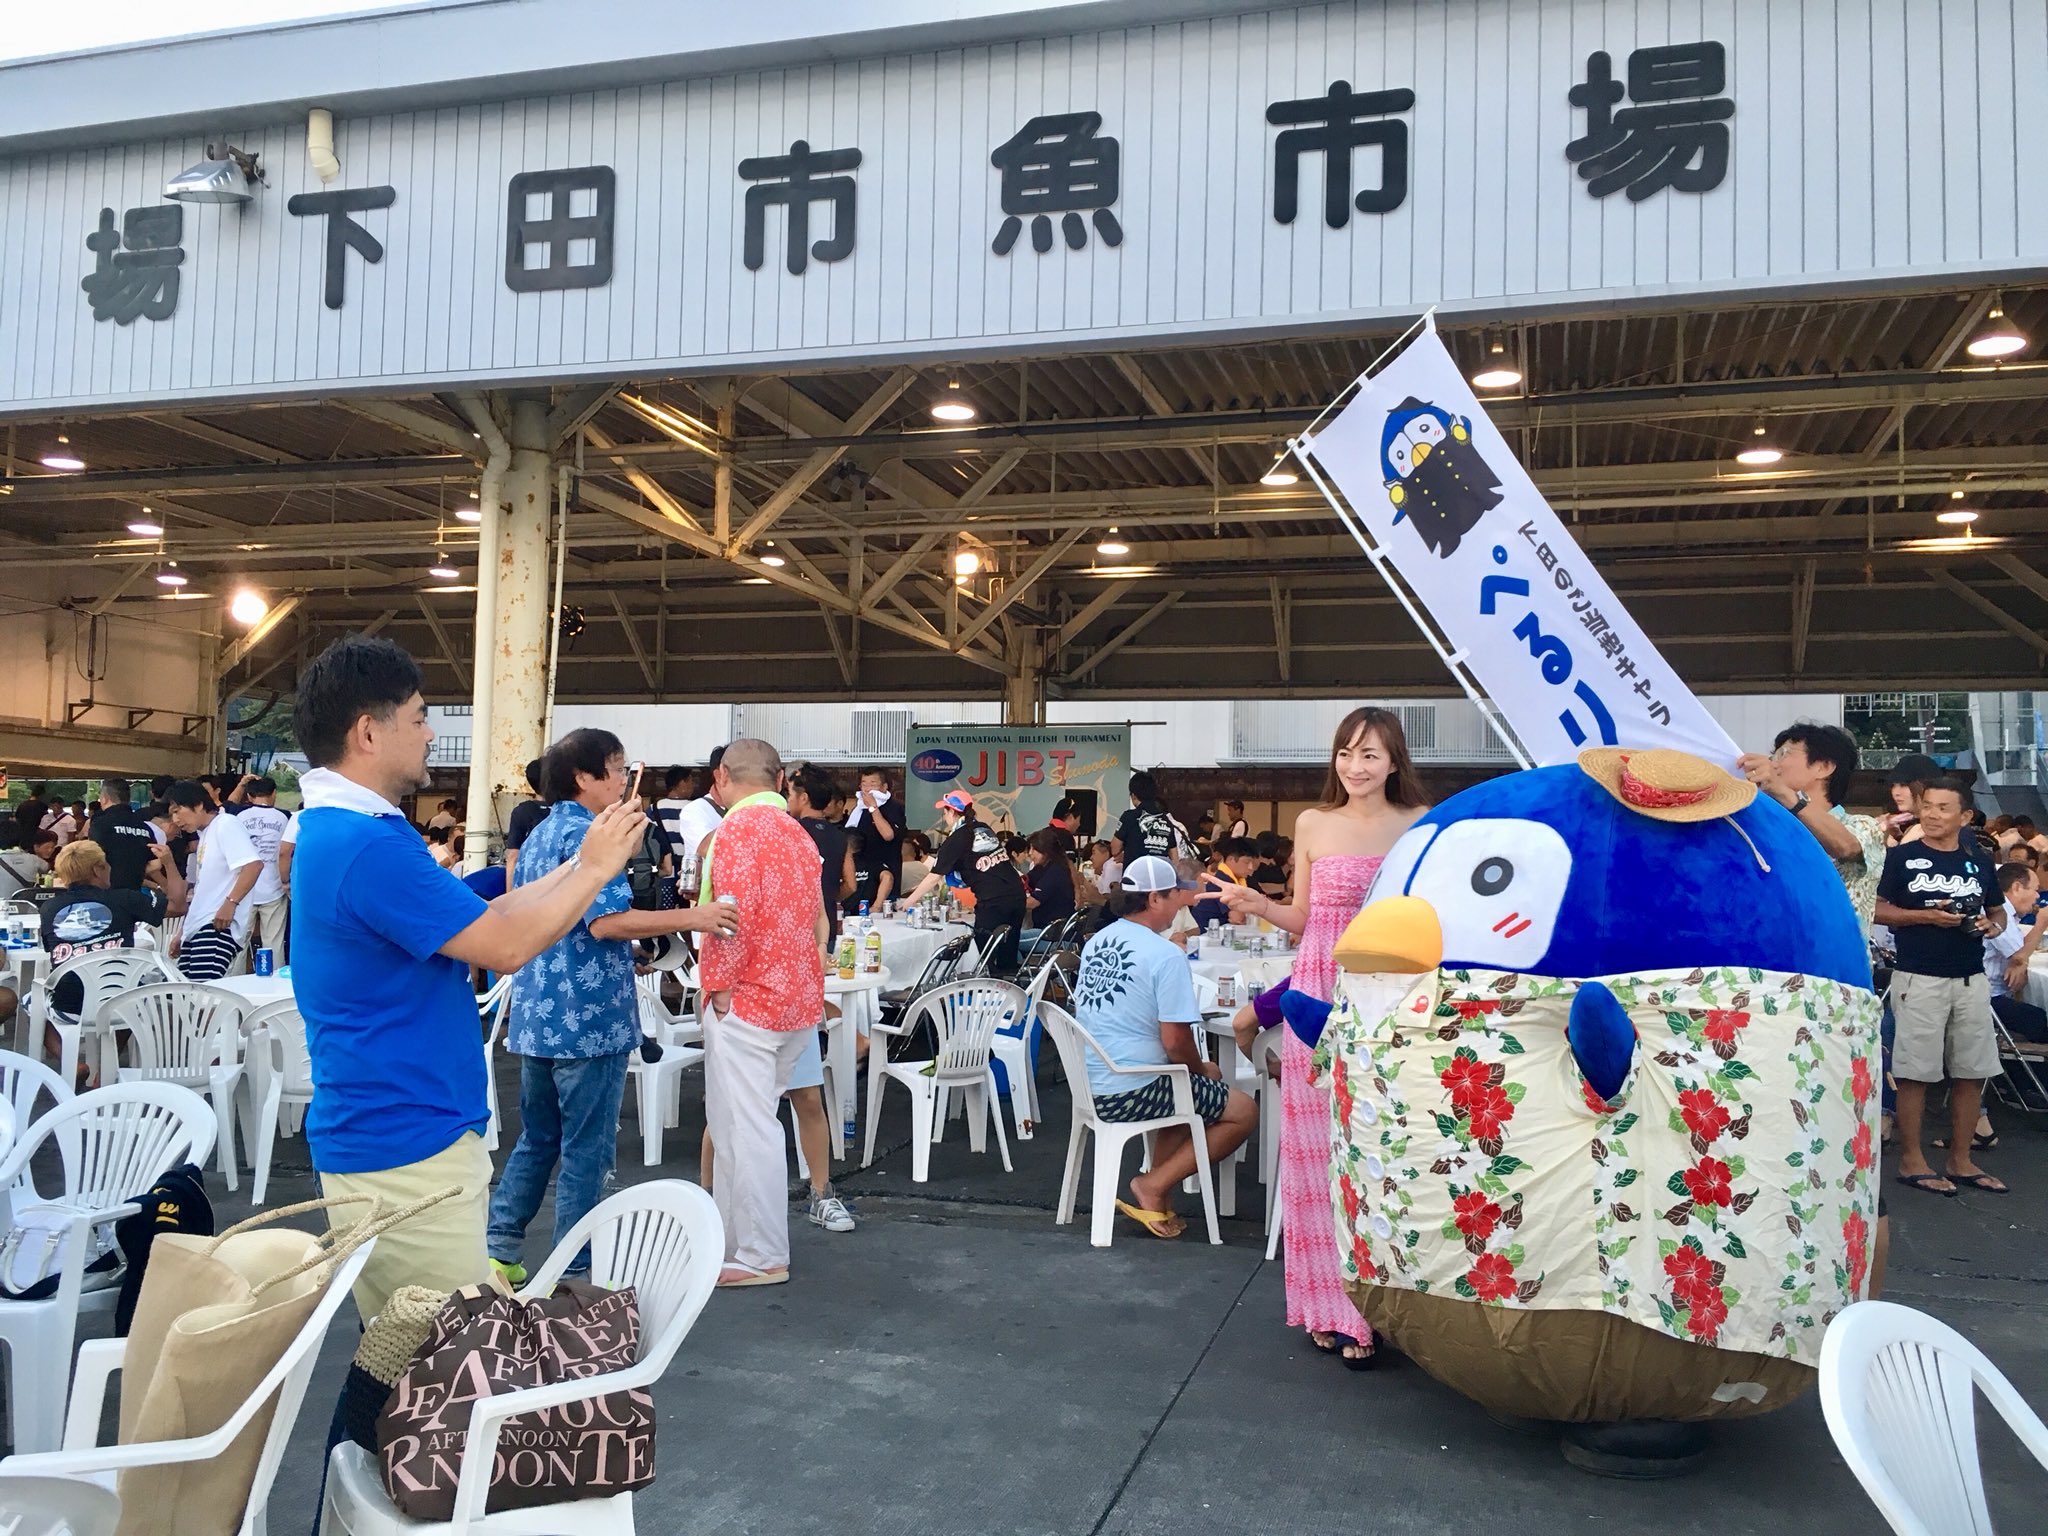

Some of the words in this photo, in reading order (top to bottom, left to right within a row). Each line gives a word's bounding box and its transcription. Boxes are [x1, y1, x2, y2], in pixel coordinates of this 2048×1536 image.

[288, 40, 1736, 310] 下田市魚市場
[81, 203, 185, 325] 場
[1517, 519, 1671, 727] 下田のご当地キャラ
[915, 736, 941, 744] JAPAN
[947, 735, 1012, 744] INTERNATIONAL
[1018, 735, 1057, 743] BILLFISH
[1064, 734, 1122, 743] TOURNAMENT
[968, 750, 1075, 786] JIBT
